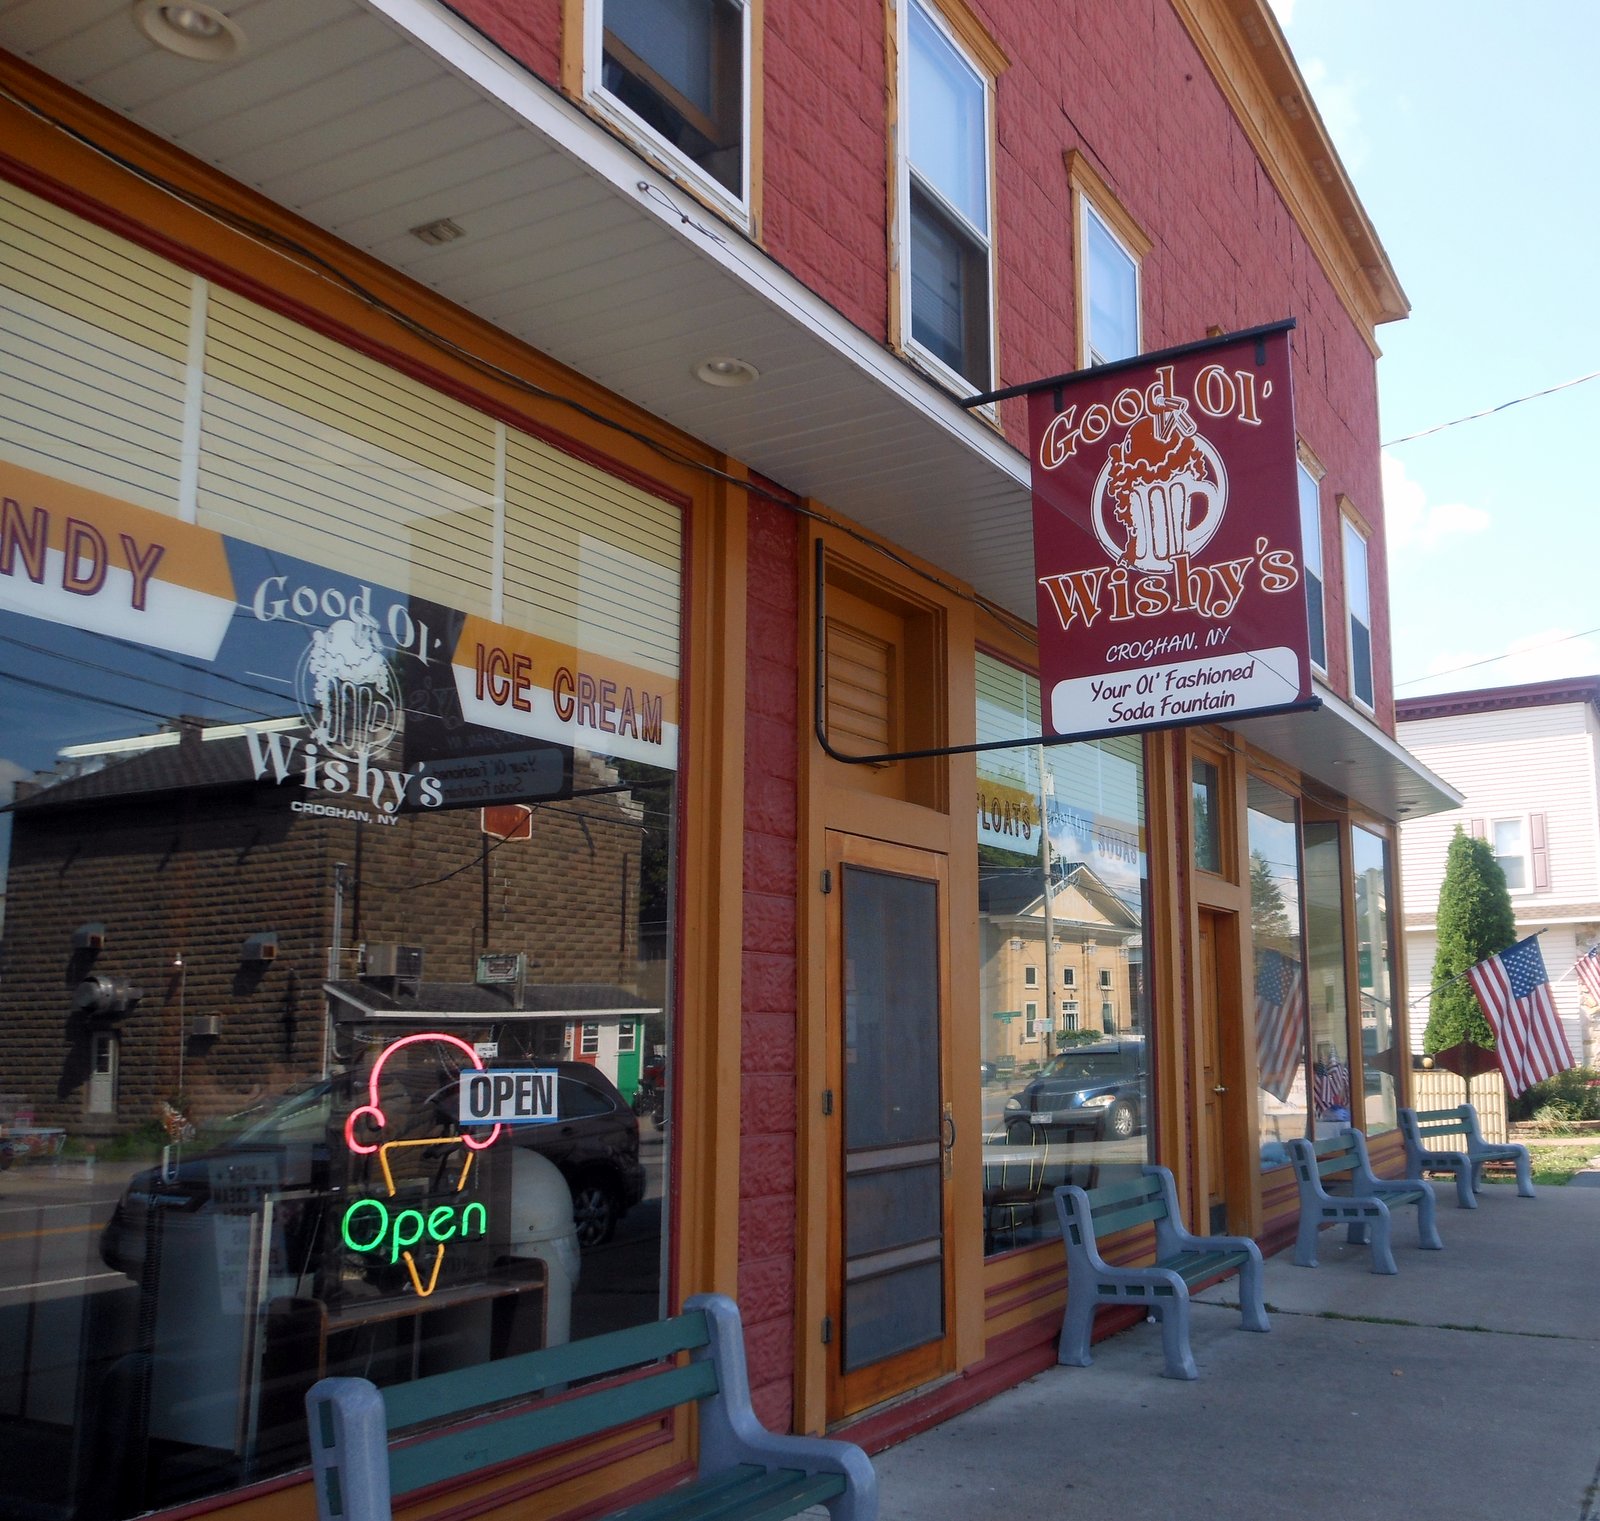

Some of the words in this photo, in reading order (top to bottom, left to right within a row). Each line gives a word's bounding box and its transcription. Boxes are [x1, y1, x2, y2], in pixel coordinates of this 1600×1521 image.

[1039, 365, 1174, 471] Good
[0, 497, 165, 612] NDY
[253, 575, 372, 623] Good
[1038, 536, 1299, 631] Wishy's
[1205, 625, 1232, 647] NY
[475, 642, 532, 713] ICE
[553, 666, 662, 745] CREAM
[1091, 680, 1131, 703] Your
[1164, 660, 1255, 692] Fashioned
[1108, 702, 1154, 723] Soda
[1159, 691, 1236, 716] Fountain
[241, 725, 443, 814] Wishy's
[377, 808, 399, 826] NY
[976, 792, 1032, 841] LOATS
[469, 1074, 553, 1118] OPEN
[341, 1198, 487, 1265] Open
